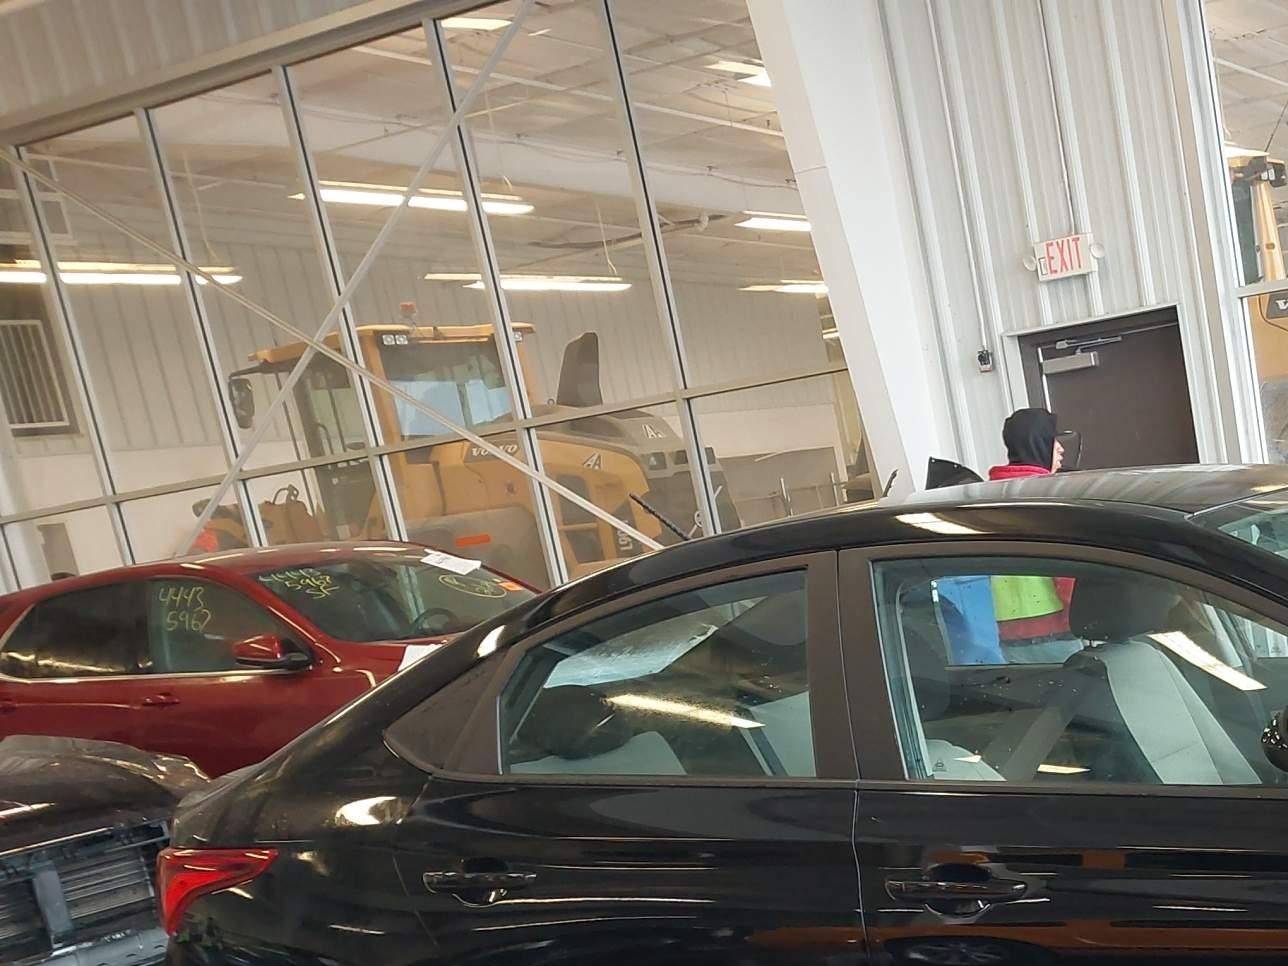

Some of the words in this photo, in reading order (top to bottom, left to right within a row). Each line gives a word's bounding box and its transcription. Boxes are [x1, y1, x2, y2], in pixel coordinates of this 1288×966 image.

[1046, 236, 1081, 274] EXIT
[158, 586, 205, 611] 4443
[165, 608, 213, 632] 5967
